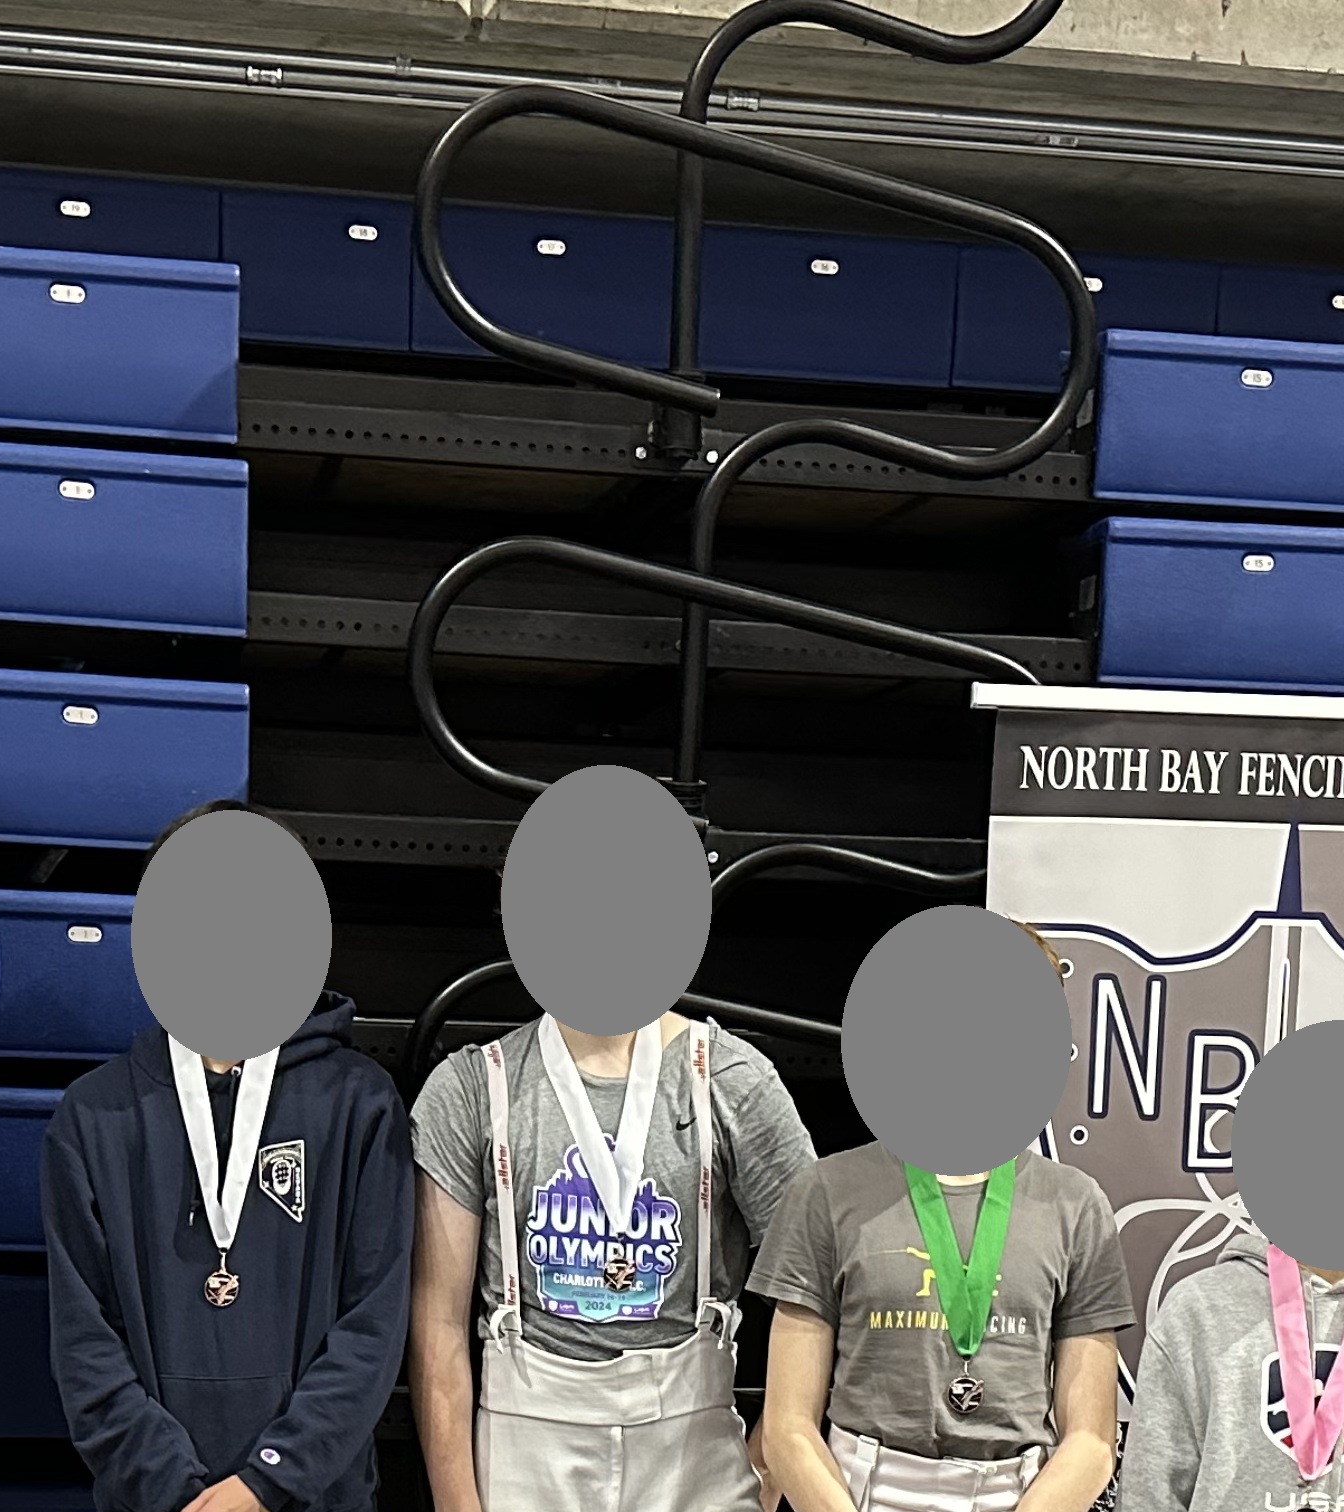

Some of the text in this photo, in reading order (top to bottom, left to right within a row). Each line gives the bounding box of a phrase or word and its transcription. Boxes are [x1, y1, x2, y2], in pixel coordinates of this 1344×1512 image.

[1020, 745, 1148, 791] NORTH
[1158, 748, 1231, 794] BAY
[530, 1234, 674, 1274] OLYMPICS
[553, 1273, 604, 1288] CHARLOTT
[585, 1301, 612, 1311] 2024
[984, 1315, 1027, 1334] CING
